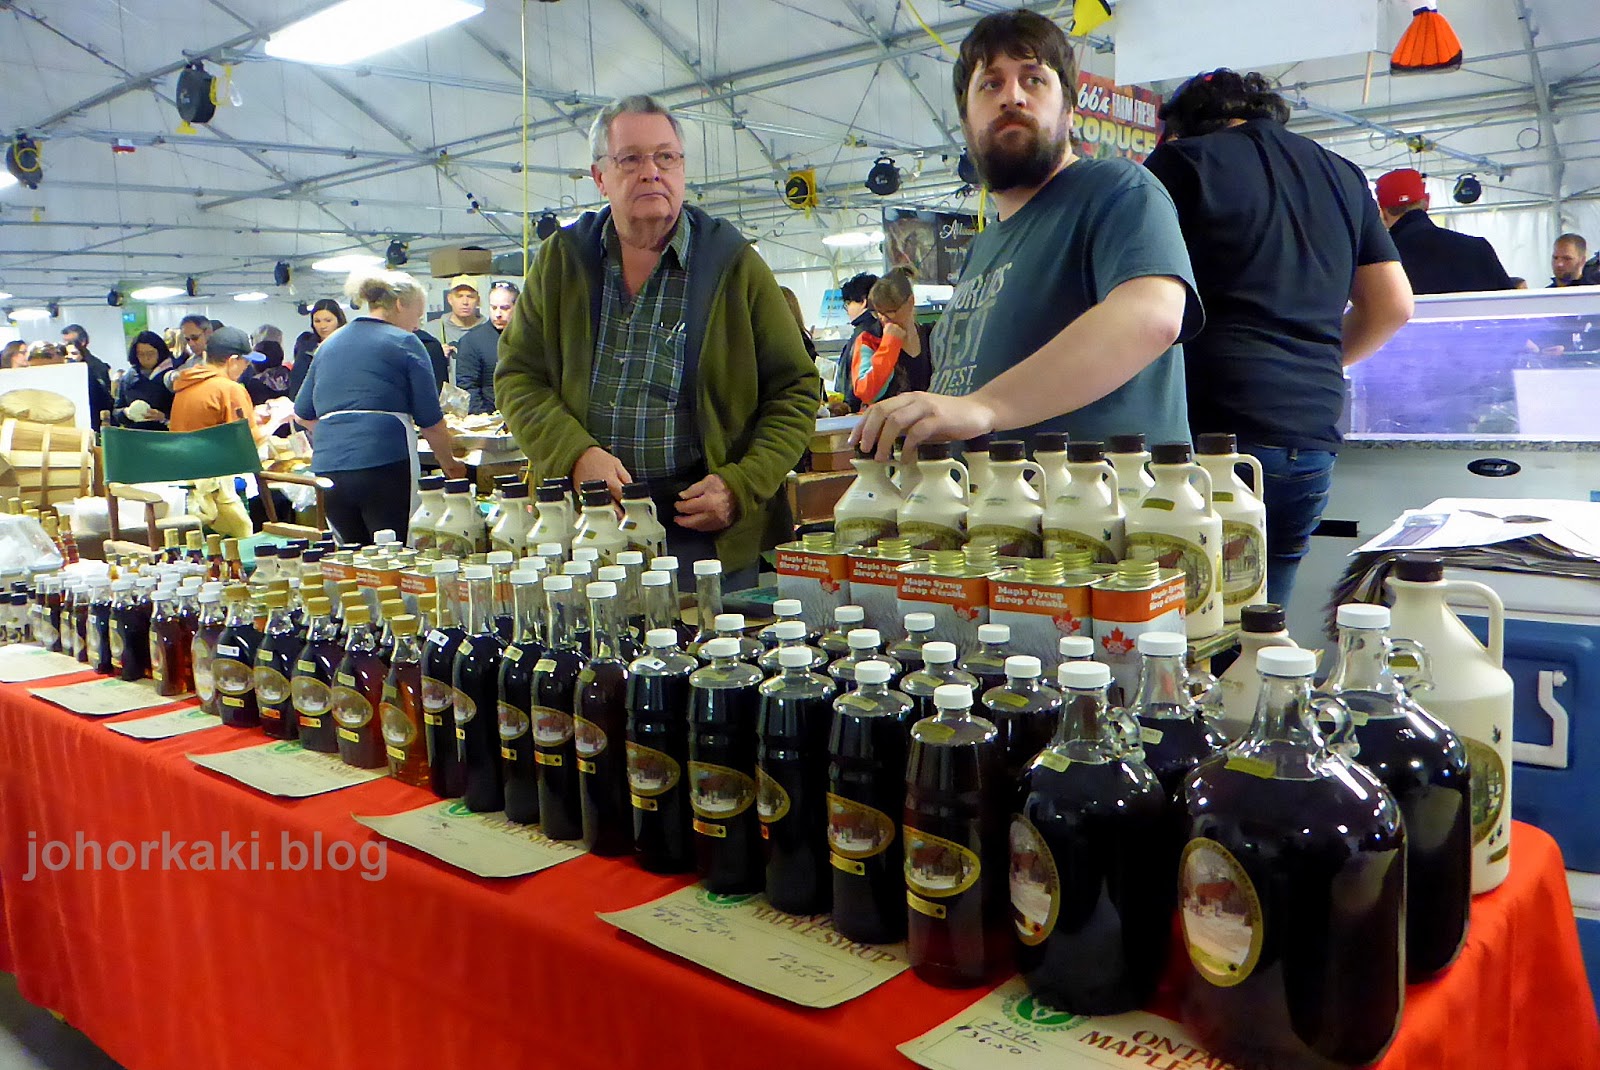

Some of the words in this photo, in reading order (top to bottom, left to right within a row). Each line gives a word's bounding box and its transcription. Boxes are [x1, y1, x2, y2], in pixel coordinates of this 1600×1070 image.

[1072, 113, 1156, 154] RODUCE
[780, 561, 800, 571] Sirop
[781, 554, 803, 564] Maple
[804, 557, 827, 567] Syrup
[855, 561, 880, 571] Maple
[881, 563, 897, 572] Syr
[853, 568, 876, 578] Sirop
[902, 585, 928, 595] Sirop
[904, 577, 932, 588] Maple
[933, 579, 963, 592] Syrup
[998, 586, 1029, 597] Maple
[1031, 589, 1064, 600] Syrup
[995, 595, 1023, 606] Sirop
[752, 905, 819, 938] MAPLE
[816, 932, 897, 963] SYRUP
